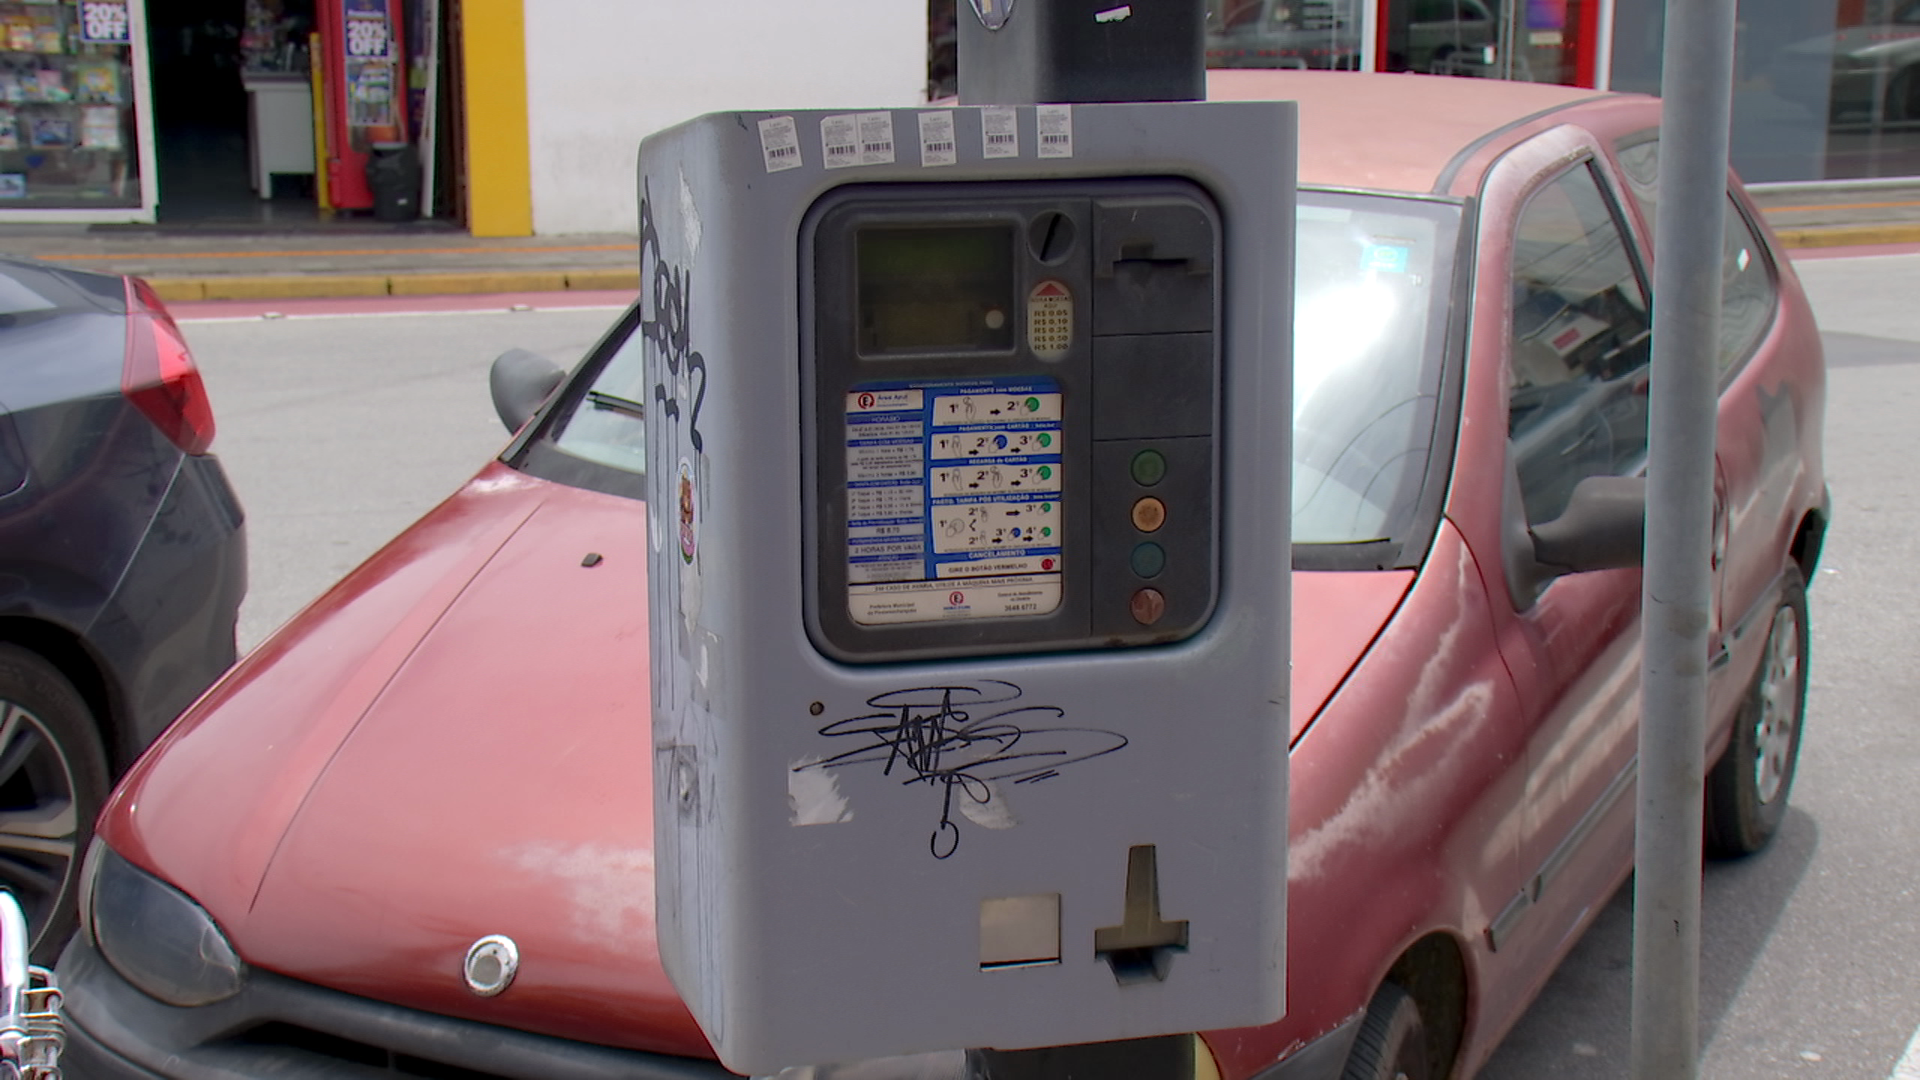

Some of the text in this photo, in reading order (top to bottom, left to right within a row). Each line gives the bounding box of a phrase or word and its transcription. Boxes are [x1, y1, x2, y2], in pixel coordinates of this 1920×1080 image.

[84, 3, 127, 21] 20%
[87, 21, 127, 39] OFF
[348, 20, 386, 39] 20%
[349, 38, 385, 55] OFF
[993, 493, 1029, 502] UTILIZAÇÃO
[860, 545, 885, 553] HORAS
[887, 544, 902, 552] POR
[969, 549, 1026, 559] CANCELAMENTO
[971, 564, 992, 572] BOTÃO
[962, 579, 989, 587] MÁQUINA
